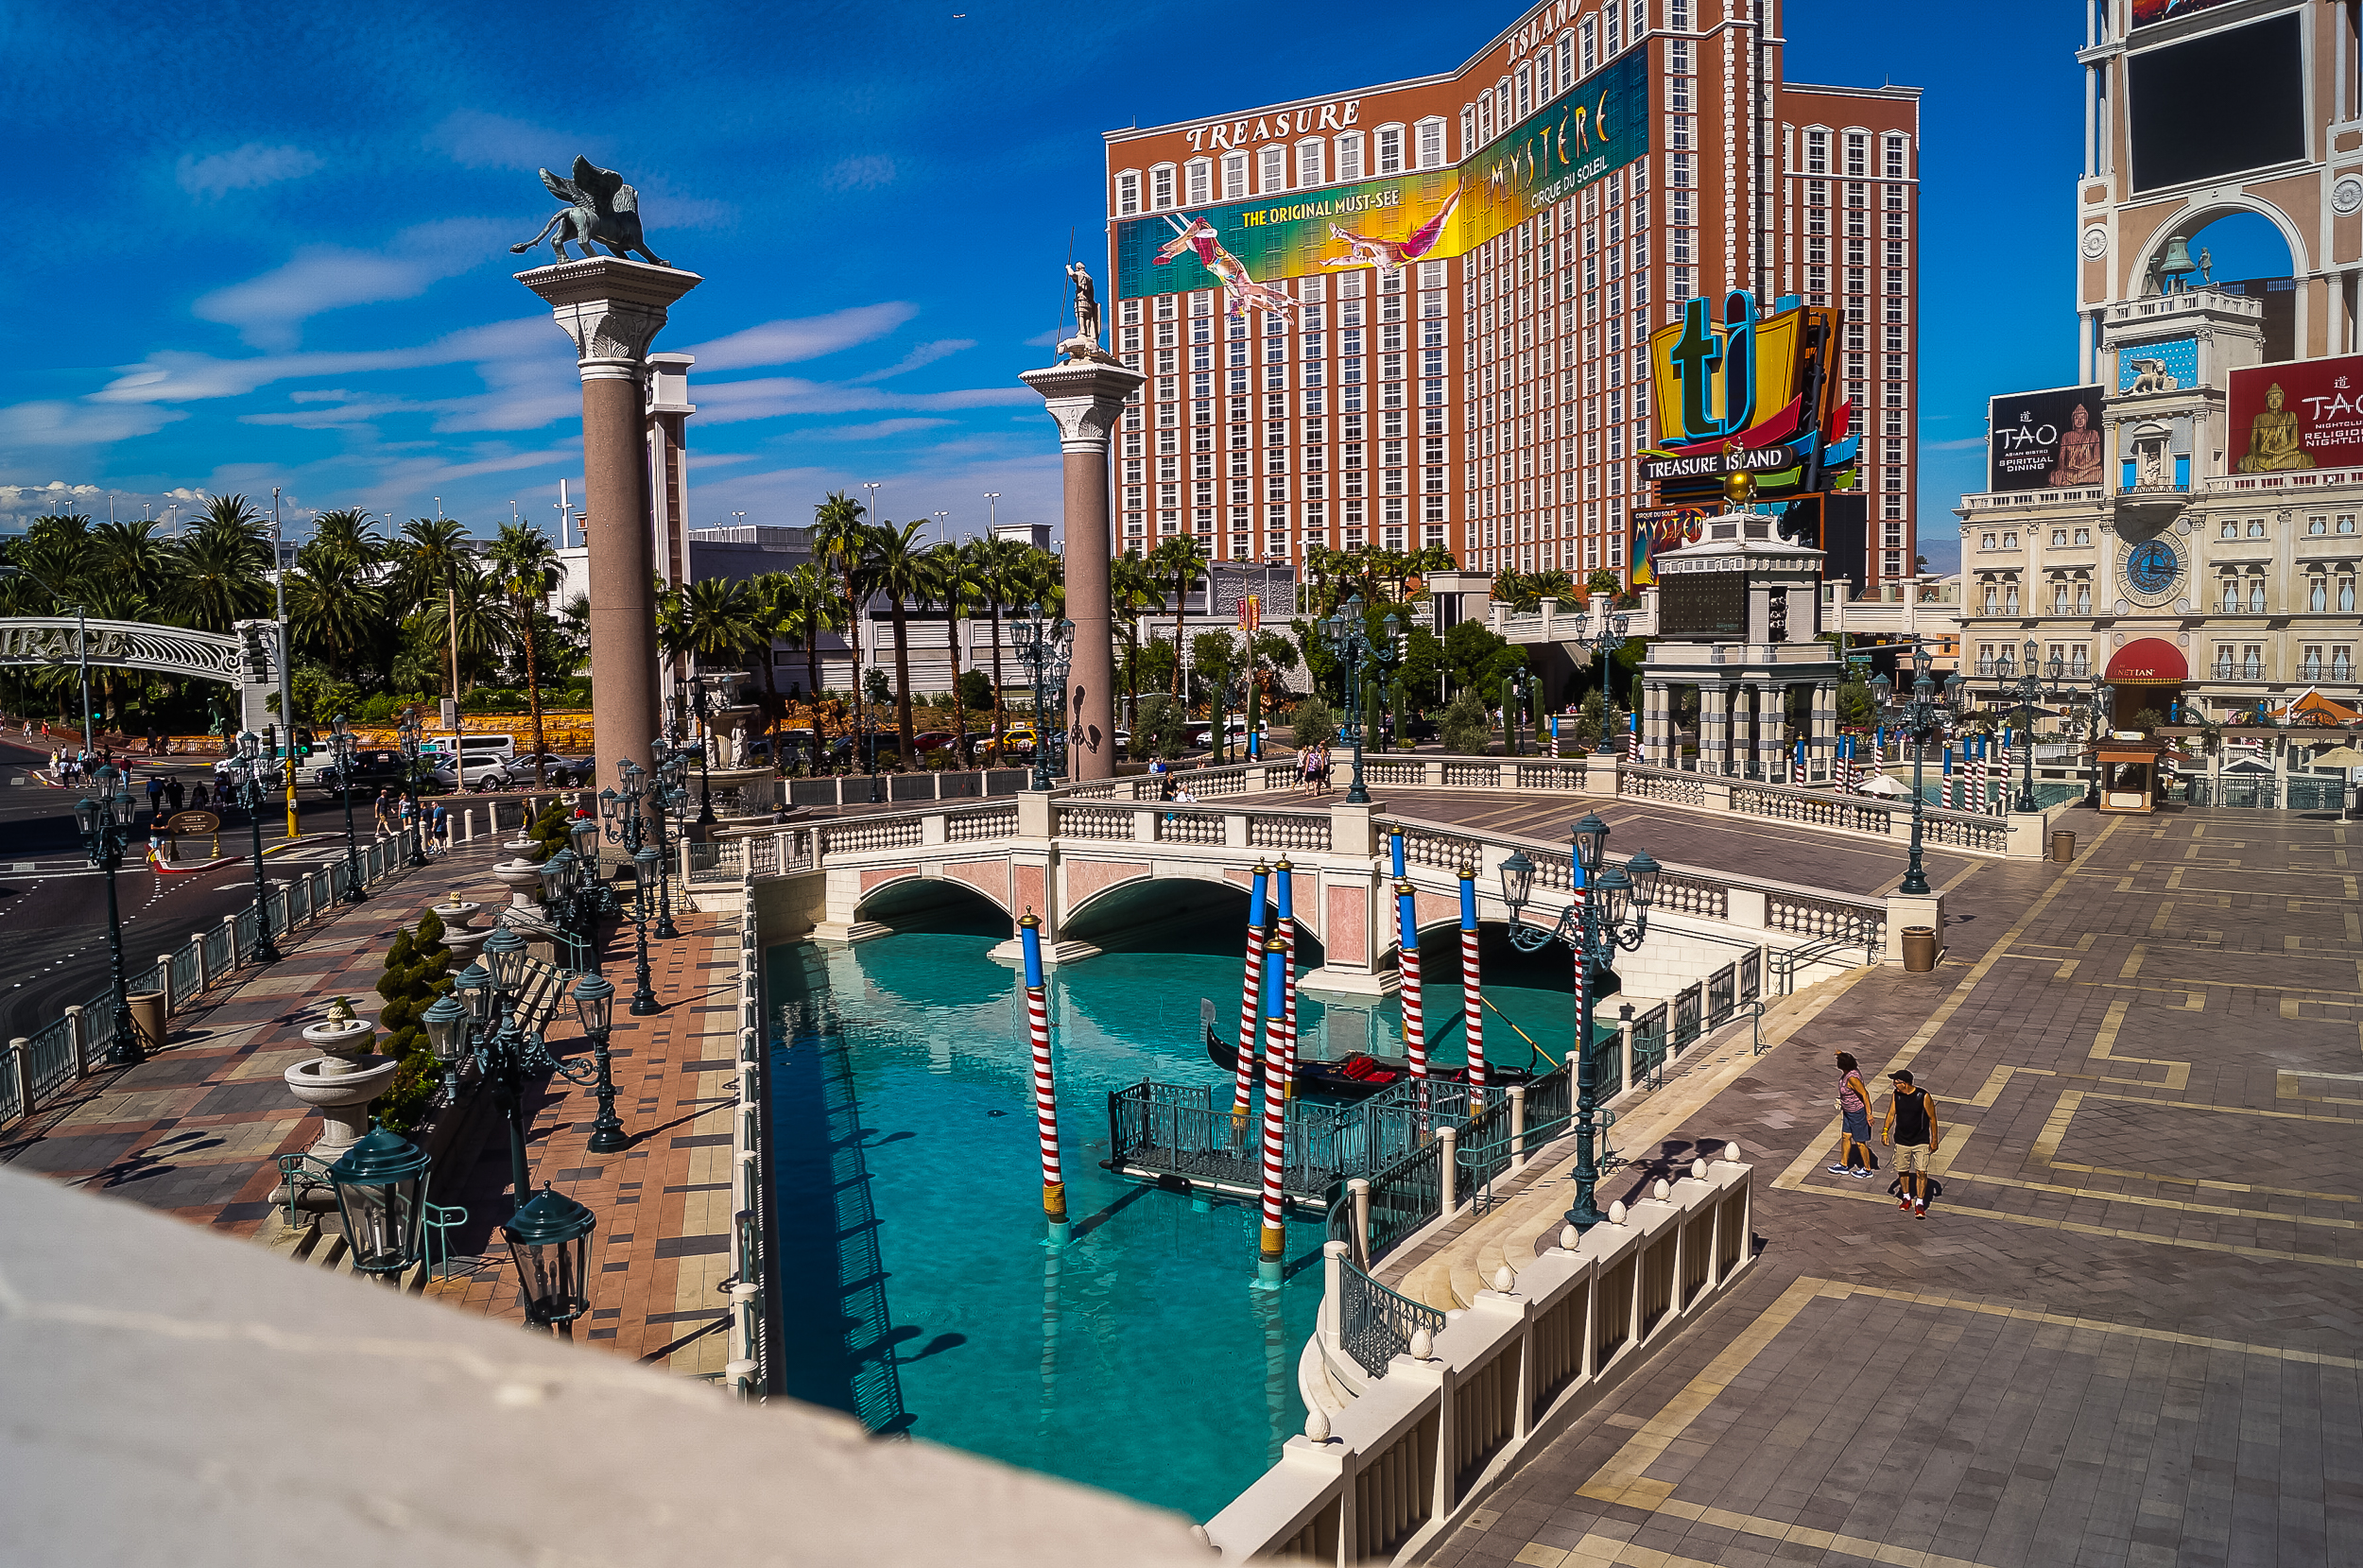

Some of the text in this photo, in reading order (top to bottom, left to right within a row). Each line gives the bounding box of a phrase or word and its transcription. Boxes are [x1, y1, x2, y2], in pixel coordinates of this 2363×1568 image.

[1507, 0, 1581, 65] ISLAND
[1185, 99, 1360, 152] TREASURE
[1490, 89, 1610, 207] MYSTÈRE
[1531, 154, 1609, 209] CIRQUE DU SOLEIL
[1242, 189, 1400, 228] THE ORIGINAL MUST-SEE
[1669, 288, 1757, 439] ti
[2304, 428, 2363, 440] RELIGIO
[2315, 420, 2363, 429] NIGHTCLU
[2306, 436, 2363, 447] NIGHTLI
[1647, 456, 1717, 478] TREASURE
[1999, 456, 2054, 467] SPIRITUAL
[2007, 463, 2044, 473] DINING
[1635, 512, 1702, 542] MYSTÈR
[0, 627, 128, 659] IRAGE
